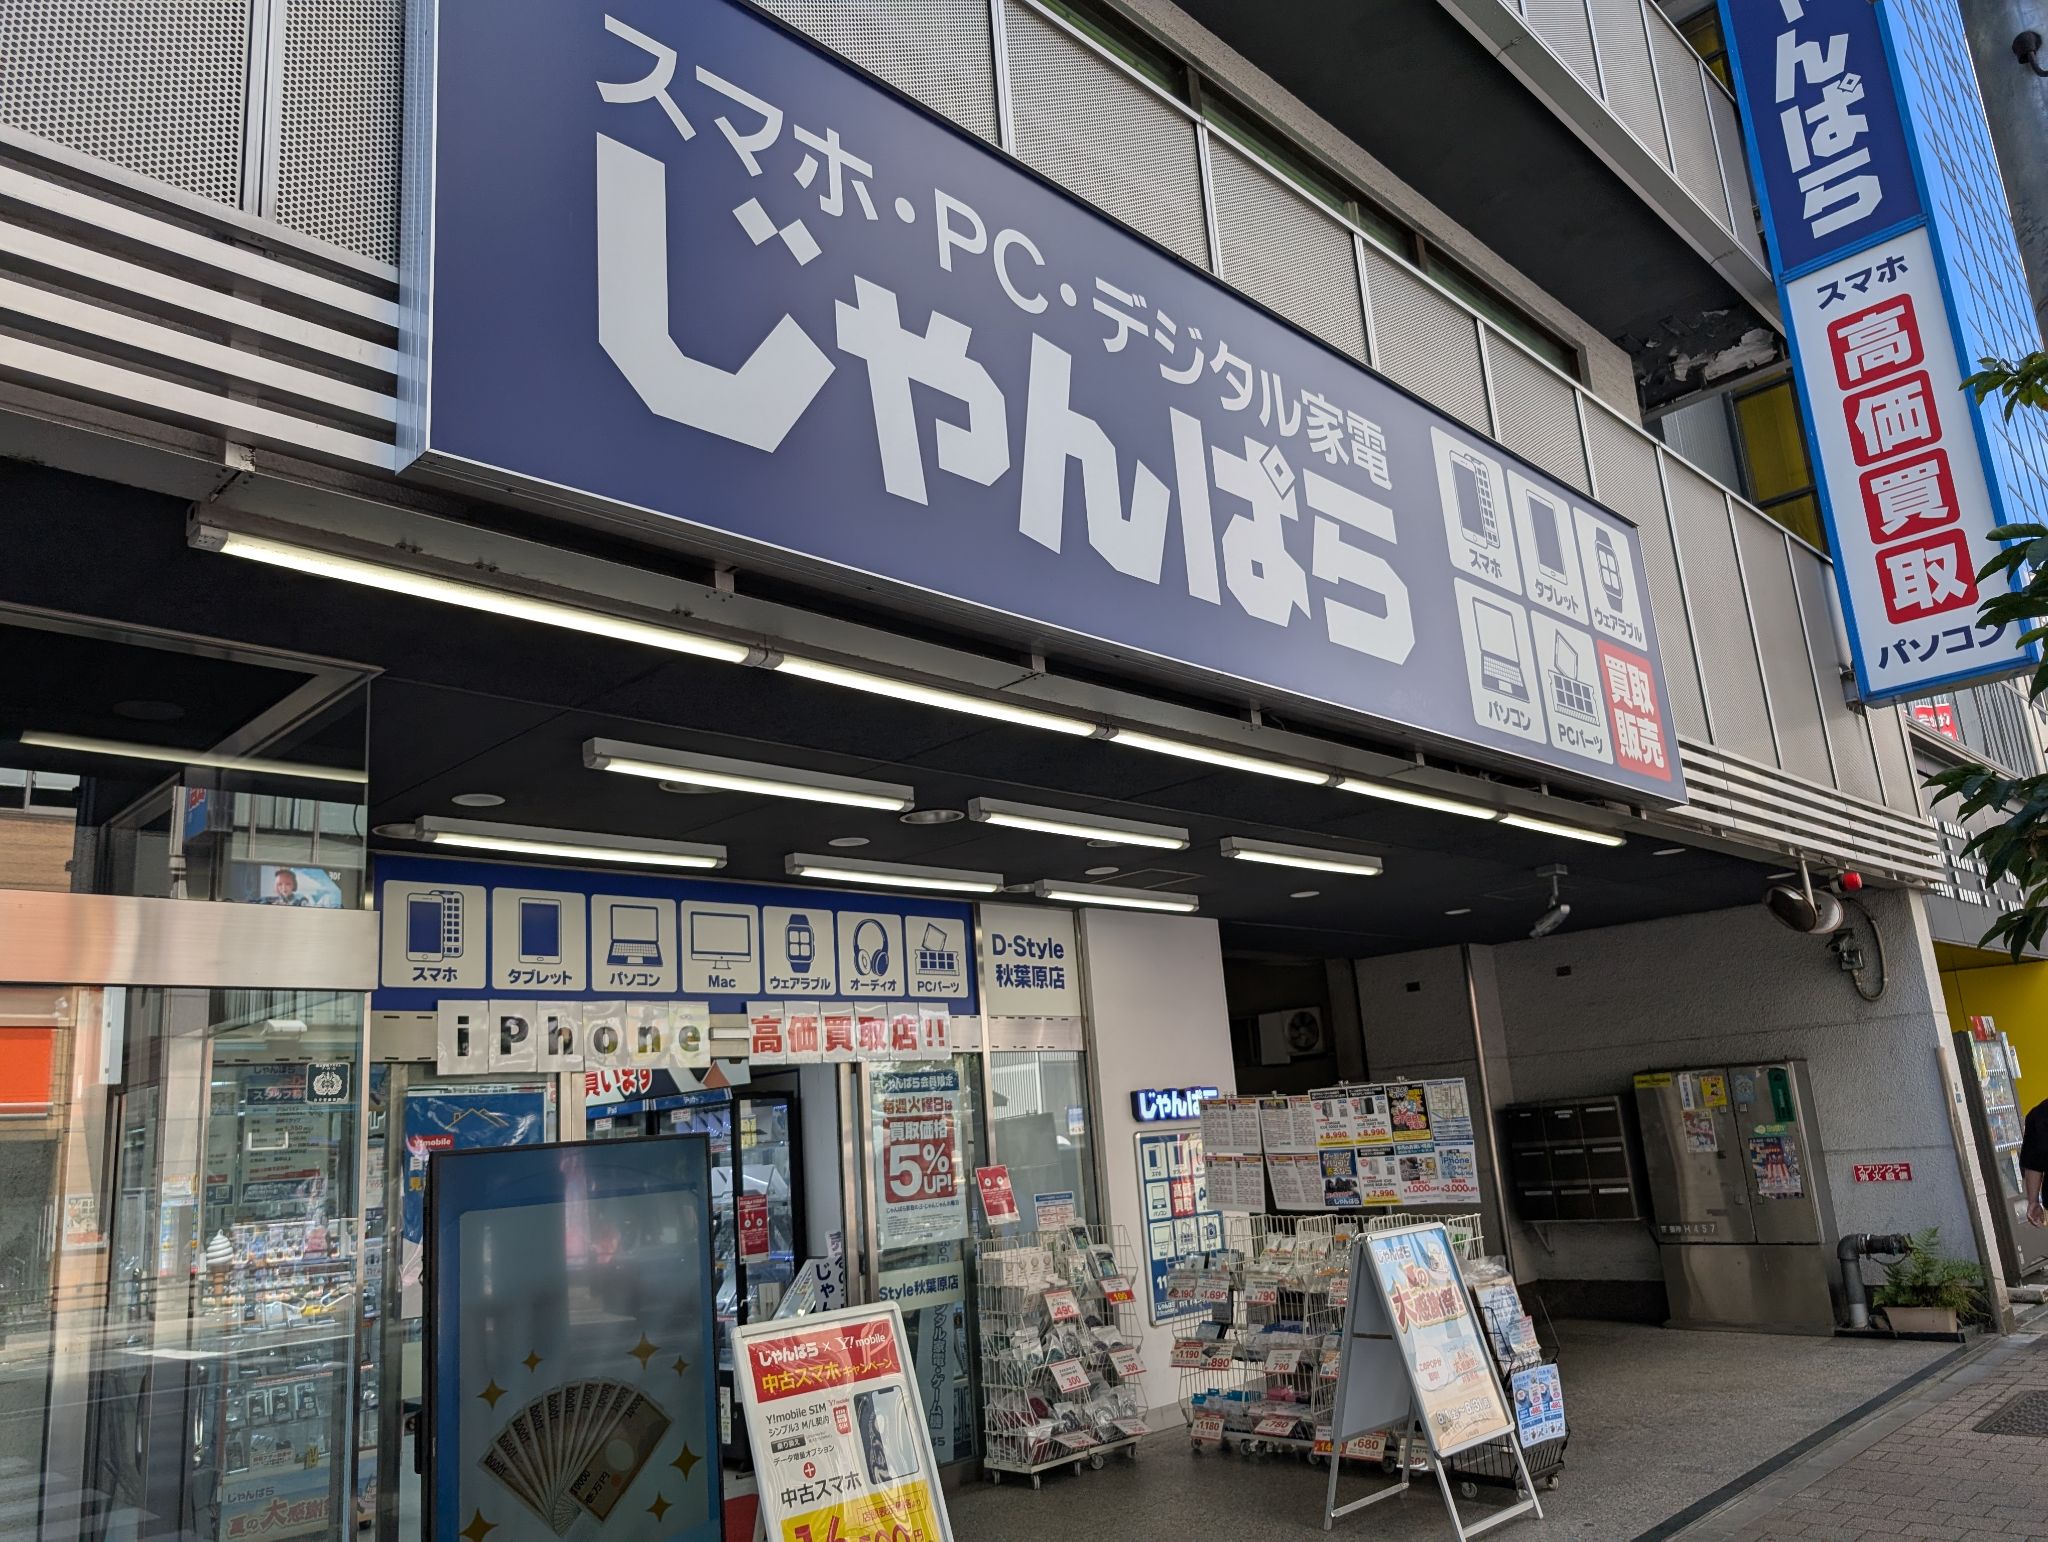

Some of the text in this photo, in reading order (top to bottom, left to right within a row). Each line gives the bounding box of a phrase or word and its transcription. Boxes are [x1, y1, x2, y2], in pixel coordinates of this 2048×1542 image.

[1774, 0, 1882, 239] んぱら
[1817, 255, 1909, 310] スマホ
[596, 131, 1416, 666] じゃんぱら
[1836, 303, 1967, 613] 高価買取
[1469, 548, 1502, 579] スマホ
[1534, 579, 1579, 613] タブレット
[1593, 607, 1643, 644] ウェアラブル
[1878, 624, 2006, 670] パソコン
[1603, 655, 1653, 717] 買取
[1487, 701, 1532, 731] パソコン
[1557, 724, 1604, 755] PCパーツ
[1614, 708, 1665, 769] 販売
[991, 933, 1065, 960] D-Style
[412, 966, 458, 982] スマホ
[508, 969, 573, 985] タブレット
[610, 972, 661, 987] パソコン
[708, 975, 737, 988] Mac
[769, 976, 831, 990] ウェアラブル
[850, 978, 897, 992] オーディオ
[917, 980, 960, 993] PCパーツ
[995, 965, 1066, 990] 秋葉原店
[457, 1015, 701, 1057] iPhone
[883, 1096, 953, 1114] 毎週火曜日は
[1139, 1089, 1218, 1119] じゃんぱ
[890, 1119, 948, 1141] 買取価格
[1857, 1165, 1908, 1173] スプリンクラー
[924, 1174, 952, 1194] UP!
[759, 1341, 819, 1367] じゃんぱら
[766, 1408, 807, 1425] Y!mobile
[809, 1403, 827, 1415] SIM
[769, 1422, 800, 1438] シンプル3
[774, 1444, 835, 1467] データ増量オプション
[1353, 1439, 1379, 1450] ¥680
[781, 1471, 862, 1509] 中古スマホ
